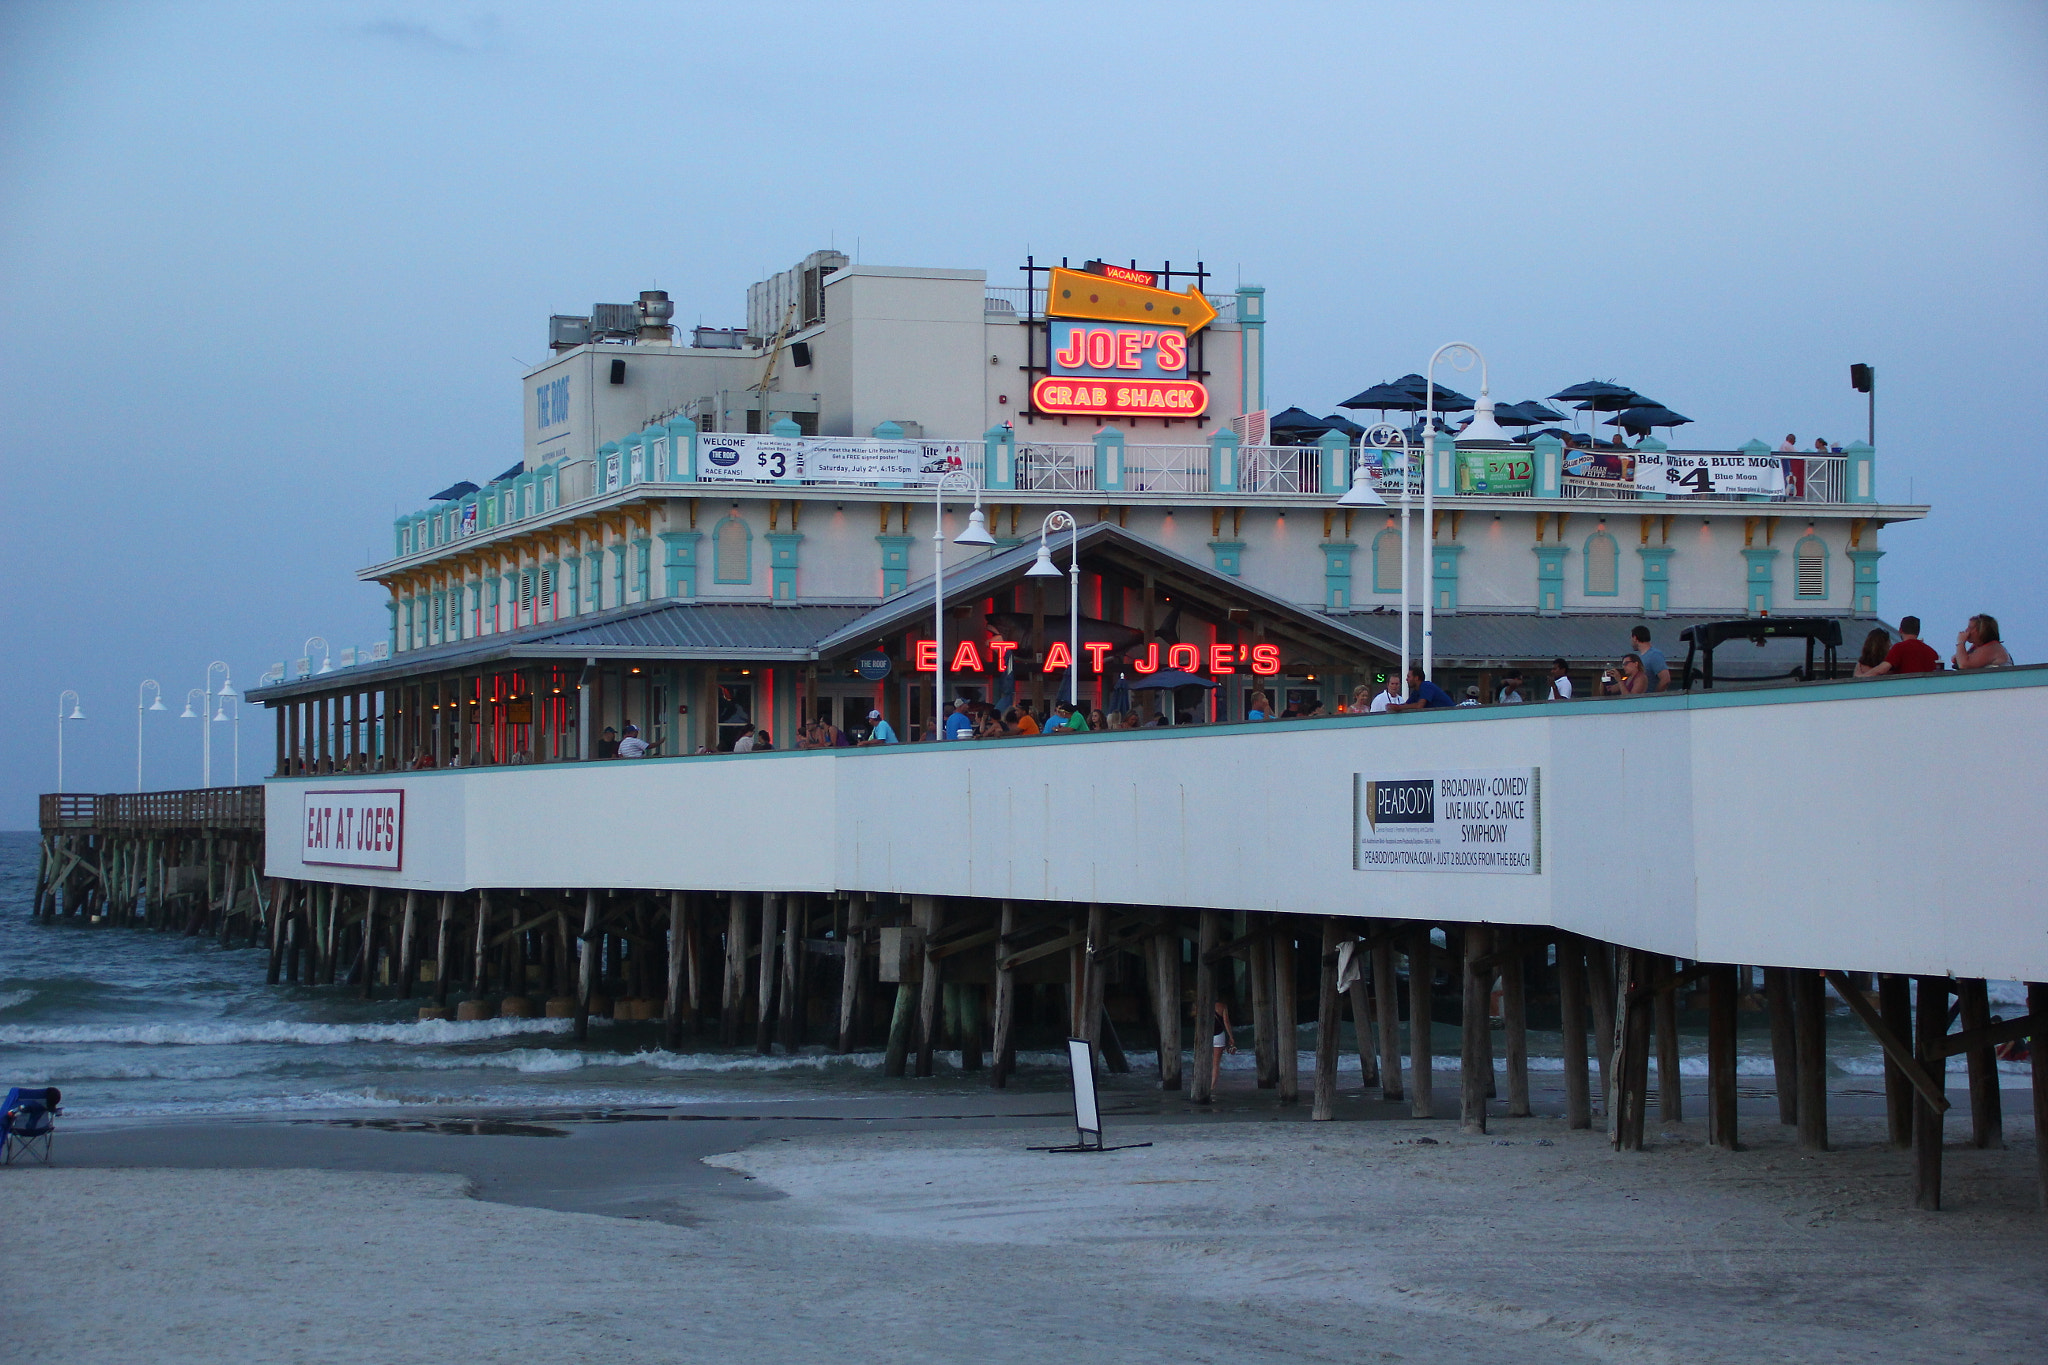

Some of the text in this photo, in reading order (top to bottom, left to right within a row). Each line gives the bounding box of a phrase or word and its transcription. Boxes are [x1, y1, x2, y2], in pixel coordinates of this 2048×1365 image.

[1107, 267, 1152, 284] VACANCY
[1055, 328, 1187, 371] JOE'S
[536, 375, 570, 429] THE ROOF
[1043, 386, 1195, 408] CRAB SHACK
[703, 437, 746, 447] WELCOME
[711, 451, 736, 459] THE ROOF
[923, 446, 938, 458] Lite
[758, 451, 786, 477] $3
[818, 464, 851, 473] Saturday,
[851, 465, 867, 473] July
[880, 465, 912, 474] 4:15-5pm
[1562, 455, 1594, 469] BLUE MOON
[1638, 455, 1780, 469] Red, White & BLUE MOON
[1580, 471, 1606, 479] WHITE
[1666, 467, 1716, 493] $4
[860, 660, 887, 668] THE ROOF
[915, 640, 1281, 675] EAT AT JOE'S
[1441, 777, 1529, 797] BROADWAY COMEDY
[1378, 786, 1433, 815] PEABODY
[1445, 801, 1525, 820] LIVE MUSIC DANCE
[307, 807, 394, 852] EAT AT JOE'S
[1461, 824, 1507, 843] SYMPHONY
[1364, 850, 1531, 867] PEABODYDAYTONA.COM JUST 2 BLOCKS FROM THE BEACH
